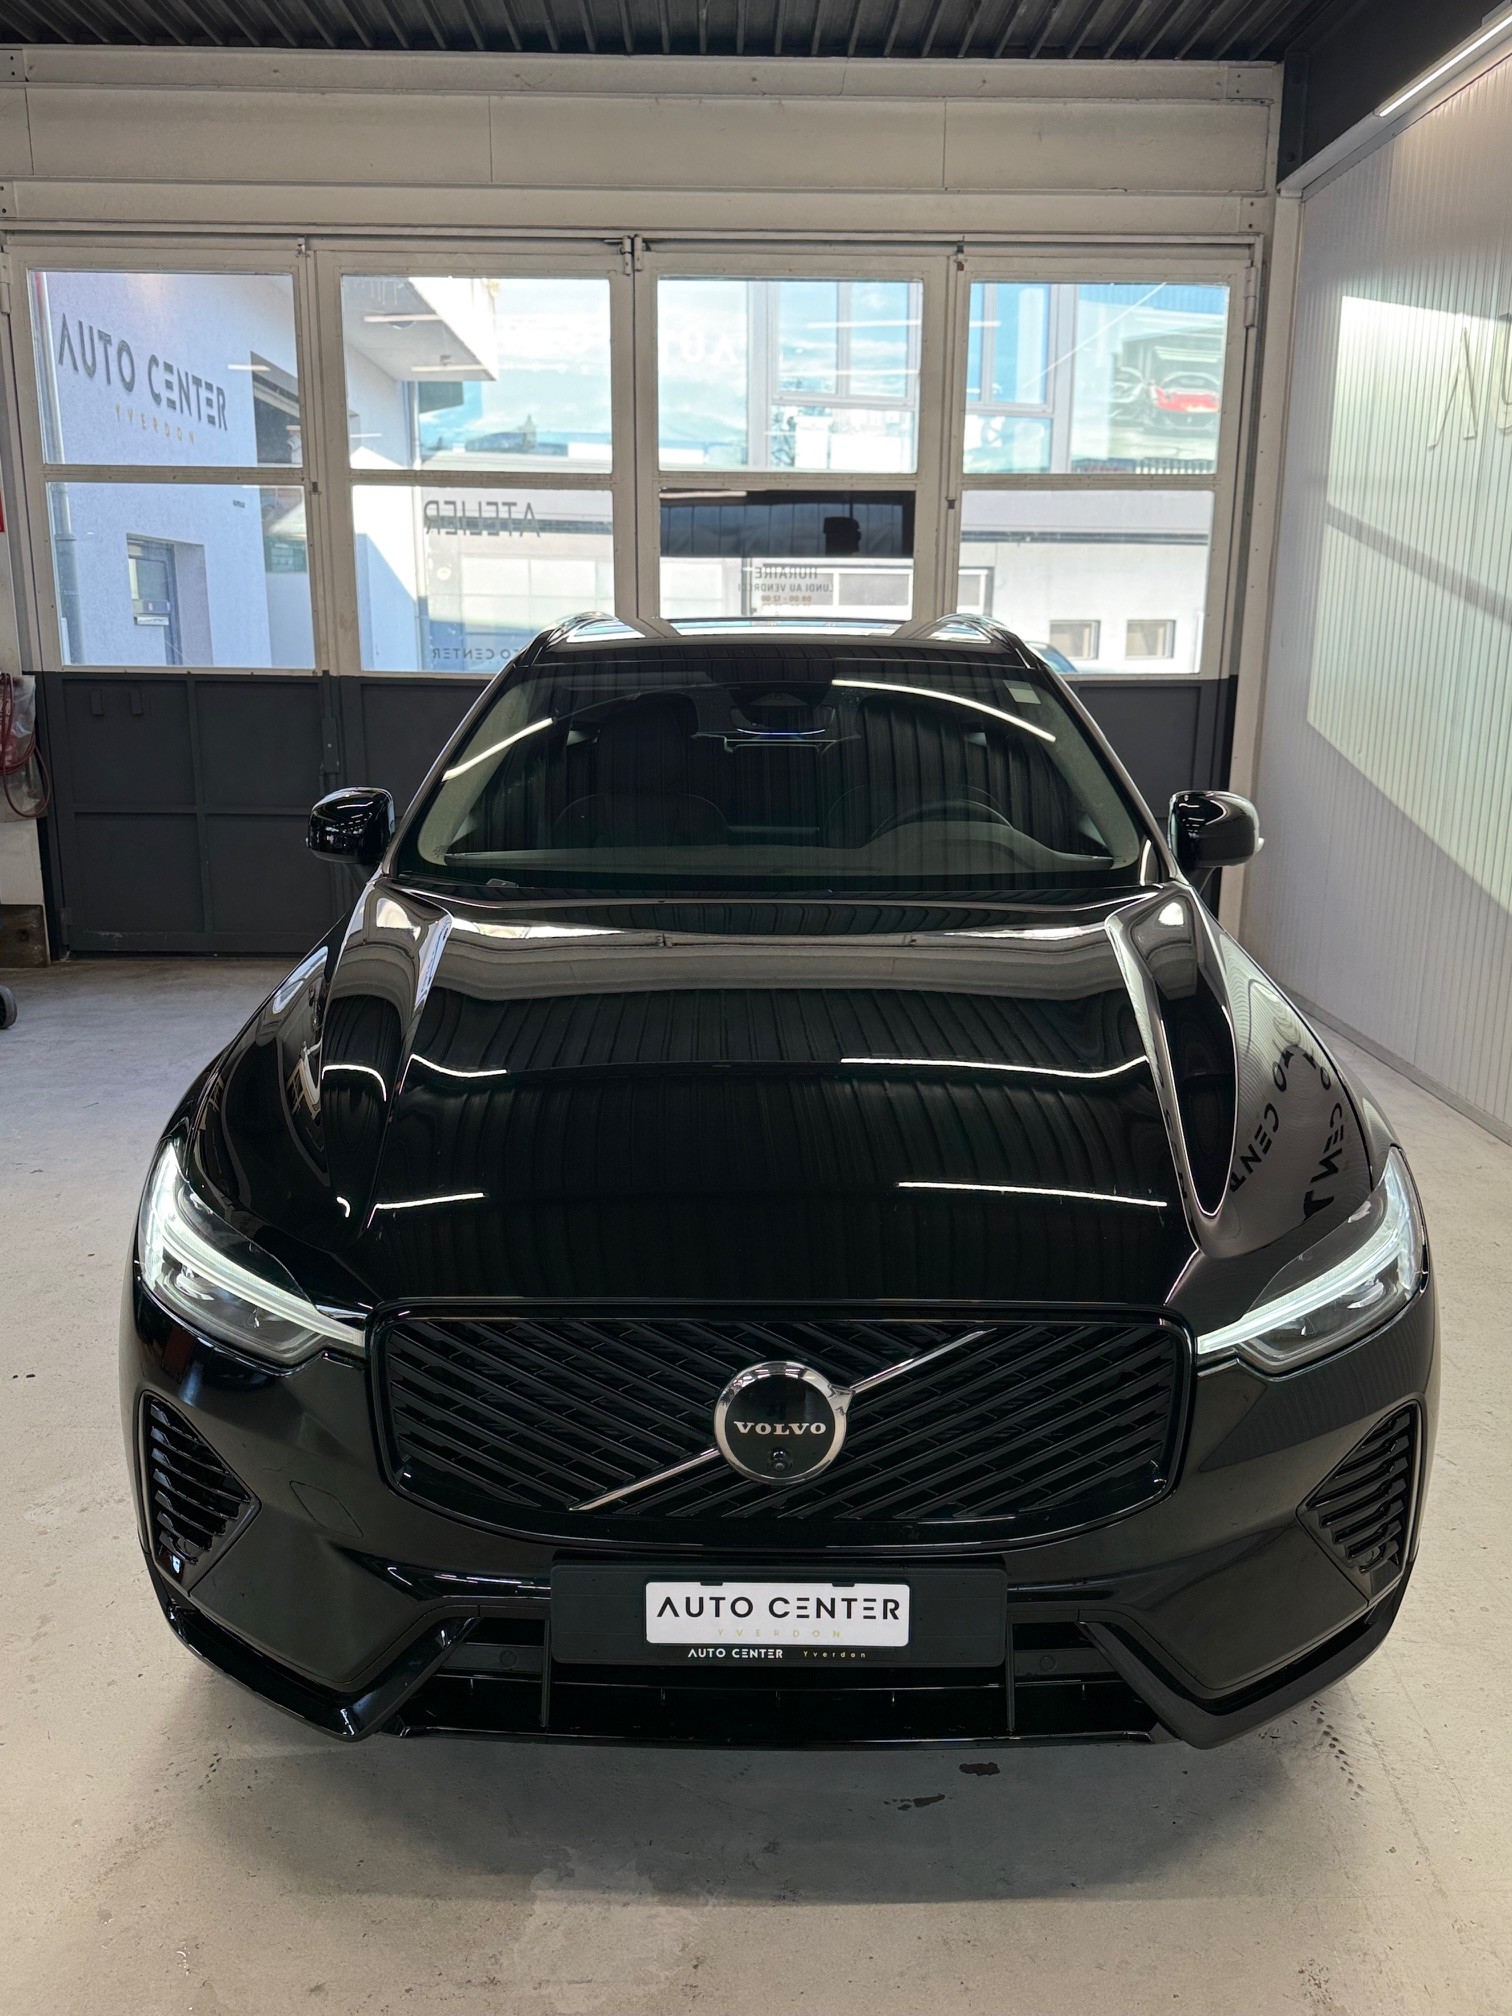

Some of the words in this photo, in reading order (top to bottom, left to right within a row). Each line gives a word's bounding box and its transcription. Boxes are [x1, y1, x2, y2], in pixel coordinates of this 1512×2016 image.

[58, 312, 136, 393] AUTO
[147, 354, 228, 431] CENTER
[114, 402, 195, 445] YVERDON
[733, 1421, 827, 1435] VOLVO
[657, 1596, 754, 1618] AUTO
[768, 1597, 900, 1620] CENTER
[717, 1628, 841, 1639] YVERDON
[687, 1648, 726, 1658] AUTO
[731, 1648, 783, 1659] CENTER
[802, 1650, 866, 1658] Yverdon
